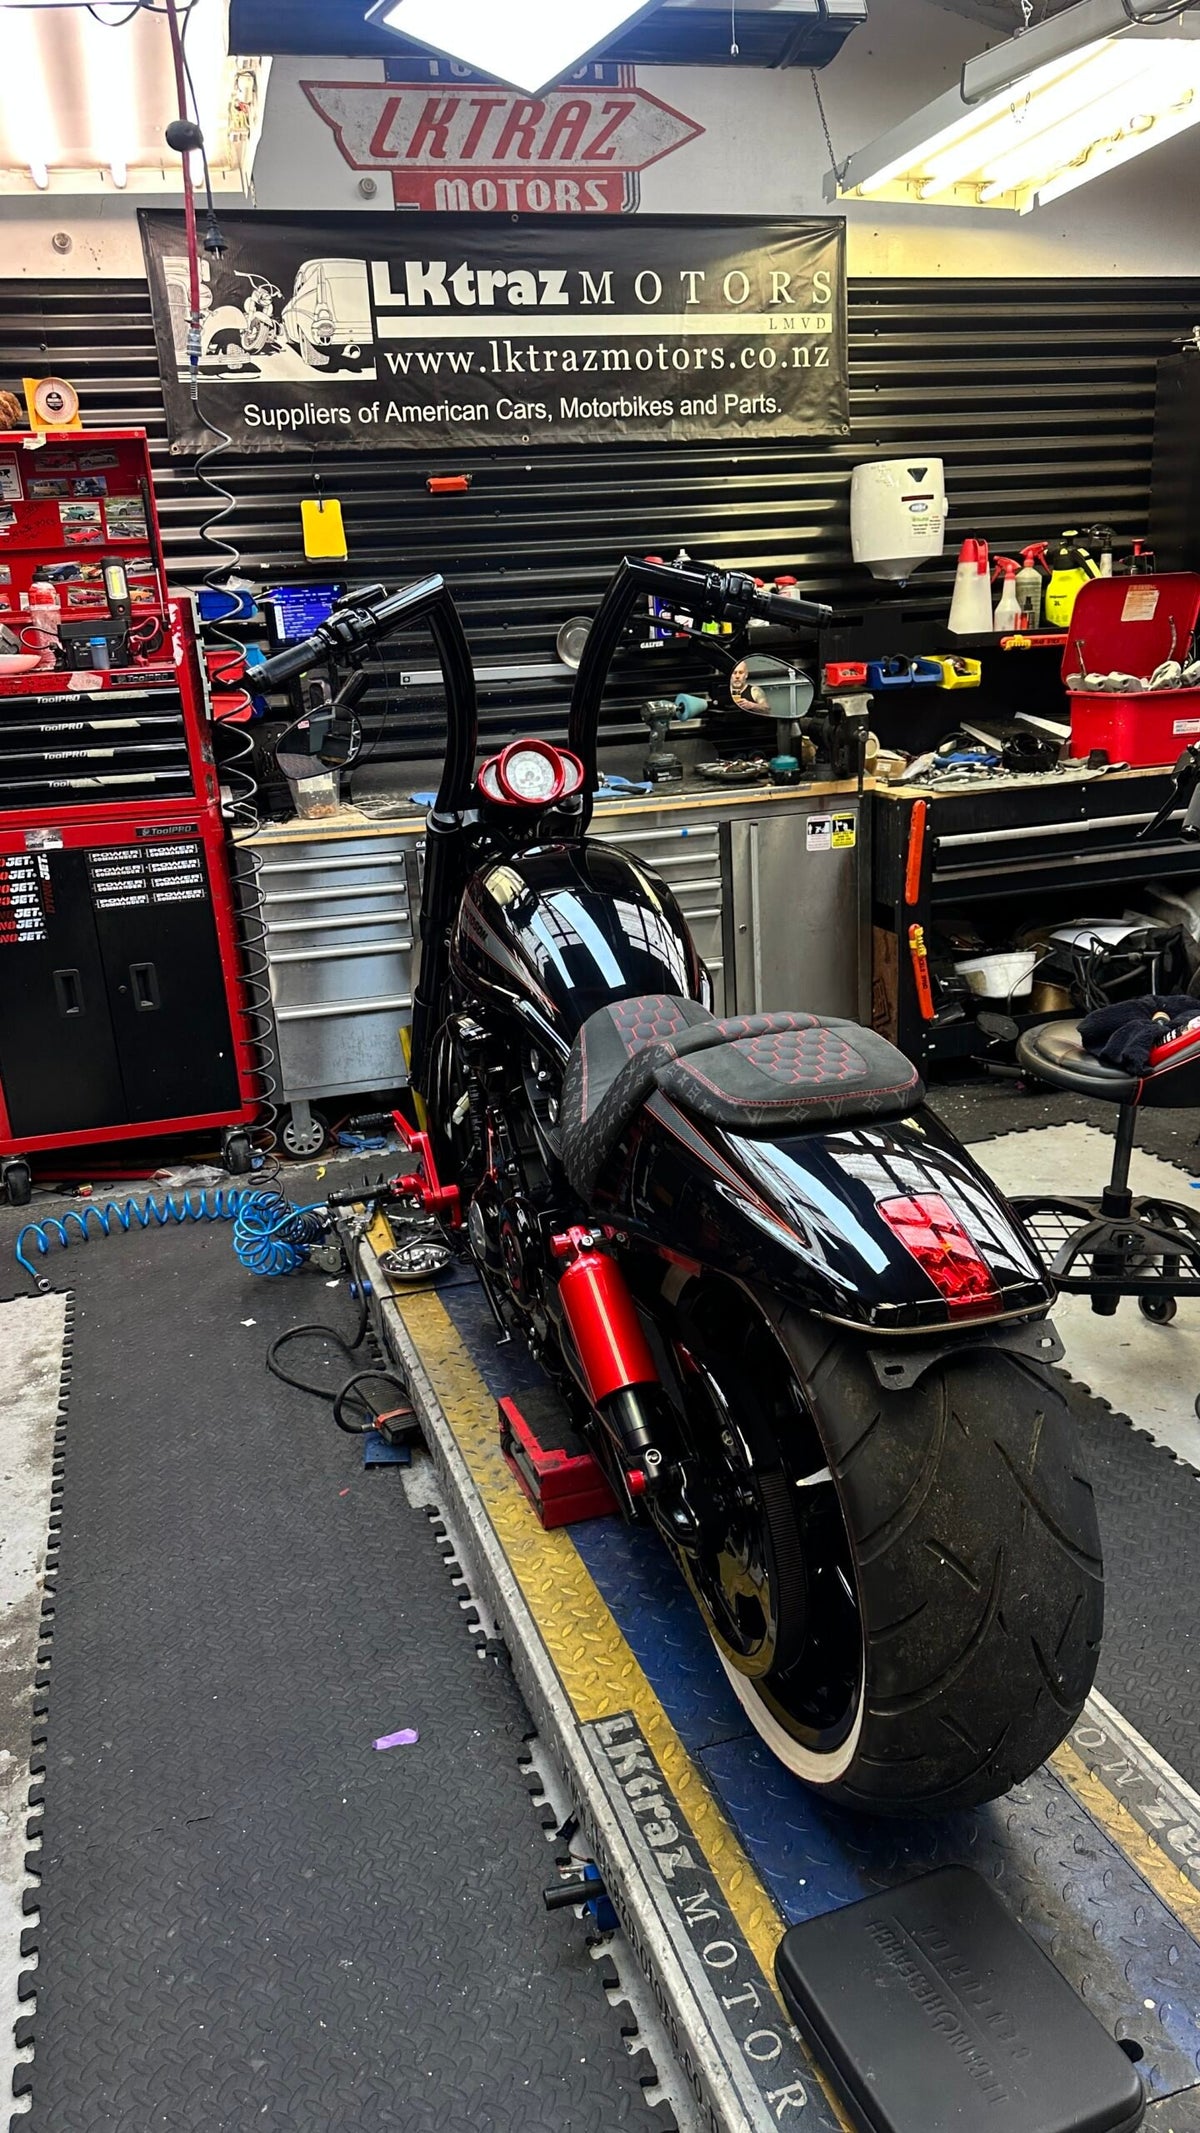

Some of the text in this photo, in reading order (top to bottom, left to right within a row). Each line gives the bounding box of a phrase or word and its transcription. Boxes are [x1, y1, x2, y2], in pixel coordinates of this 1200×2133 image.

[369, 97, 636, 160] LKTRAZ
[434, 178, 608, 212] MOTORS
[371, 260, 832, 306] LKtraz MOTORS
[768, 317, 827, 330] LMVD
[384, 340, 830, 374] www.lktrazmotors.co.nz
[244, 394, 782, 431] Suppliers of American Cars, Motorbikes and Parts.
[36, 694, 81, 704] ToolPRO
[39, 722, 84, 732] ToolPRO
[47, 780, 70, 788] Tool
[149, 845, 194, 853] POWER
[92, 850, 139, 858] POWER
[151, 859, 197, 868] POWER
[94, 865, 141, 873] POWER
[154, 874, 200, 883] POWER
[96, 879, 143, 888] POWER
[156, 889, 202, 898] POWER
[99, 895, 146, 903] POWER
[920, 1923, 1032, 2060] CENTURION
